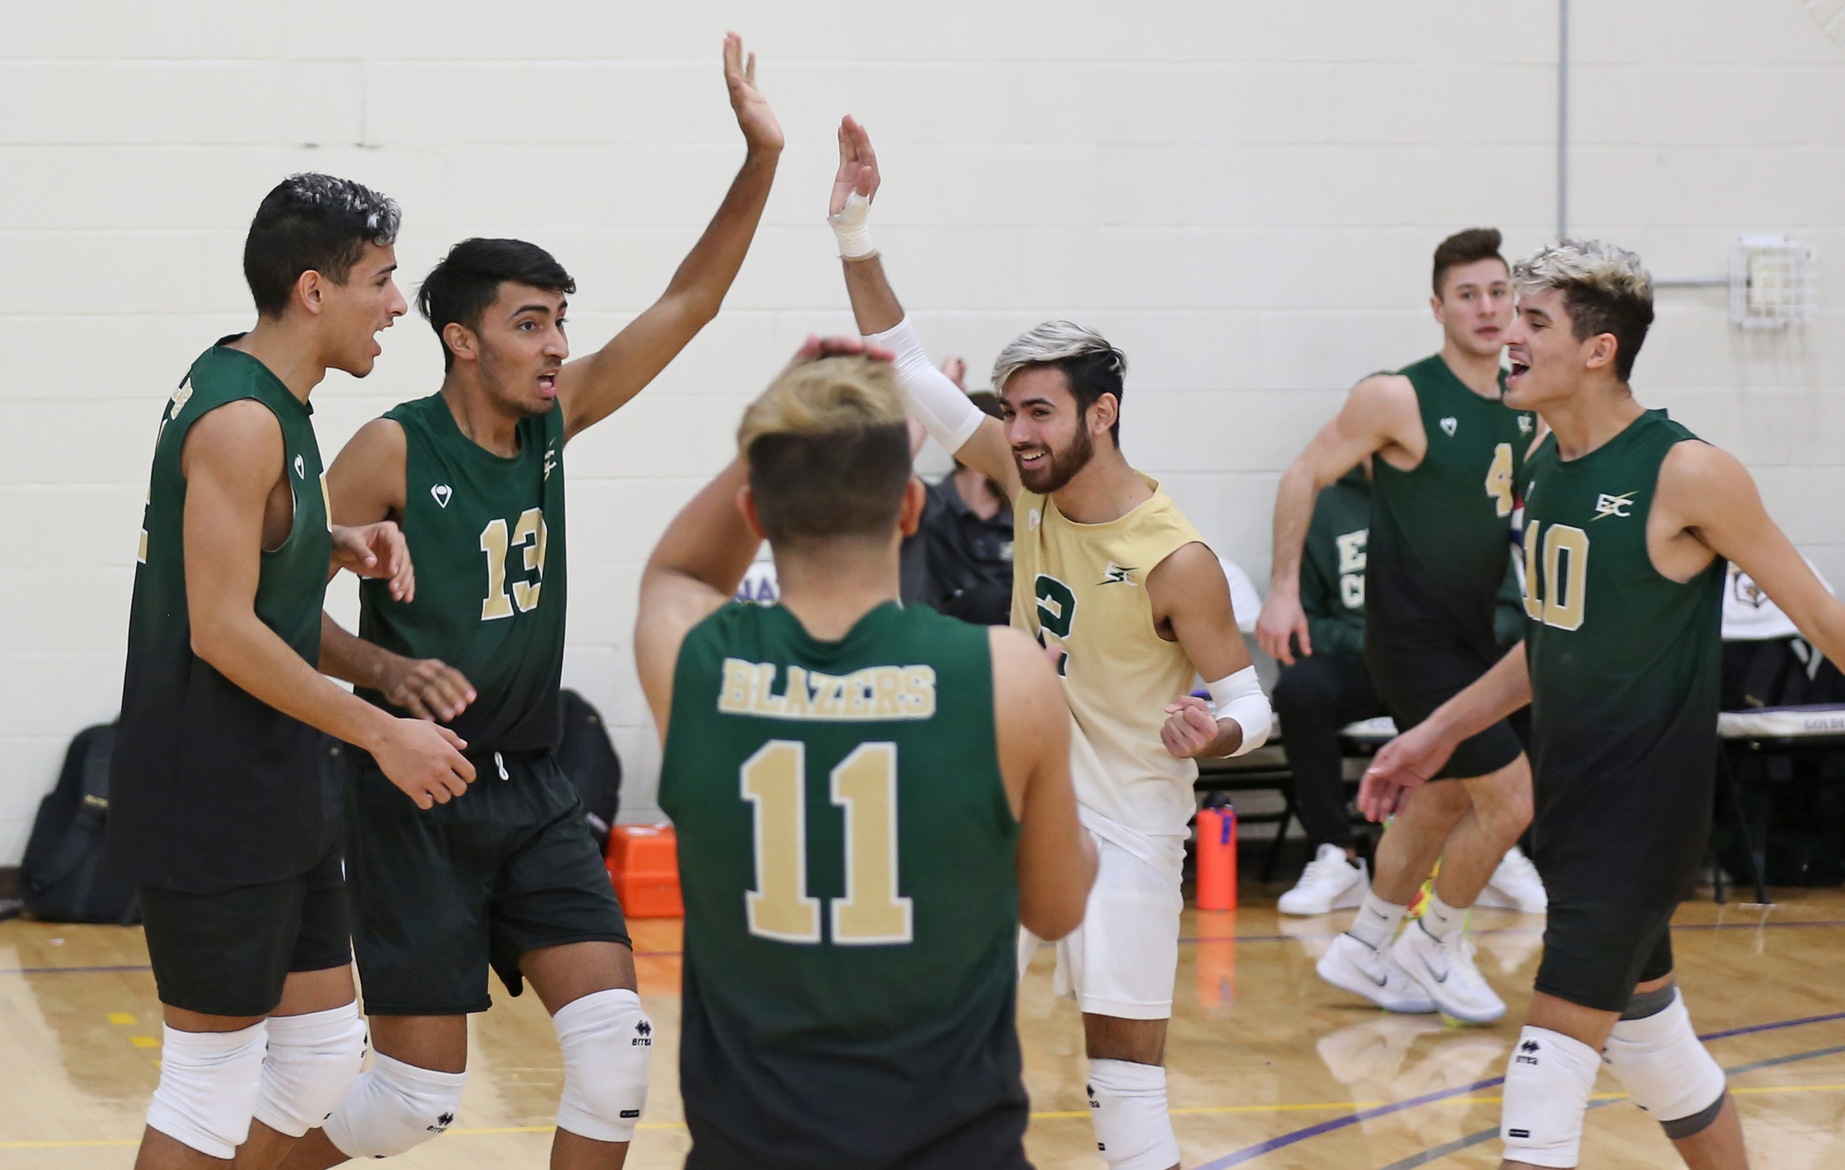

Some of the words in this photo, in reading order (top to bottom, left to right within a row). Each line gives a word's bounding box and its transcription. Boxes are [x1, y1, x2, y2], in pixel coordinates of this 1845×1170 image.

[1484, 442, 1514, 518] 4
[479, 507, 549, 622] 13
[1522, 519, 1591, 632] 10
[717, 657, 937, 722] BLAZERS
[739, 738, 914, 945] 11
